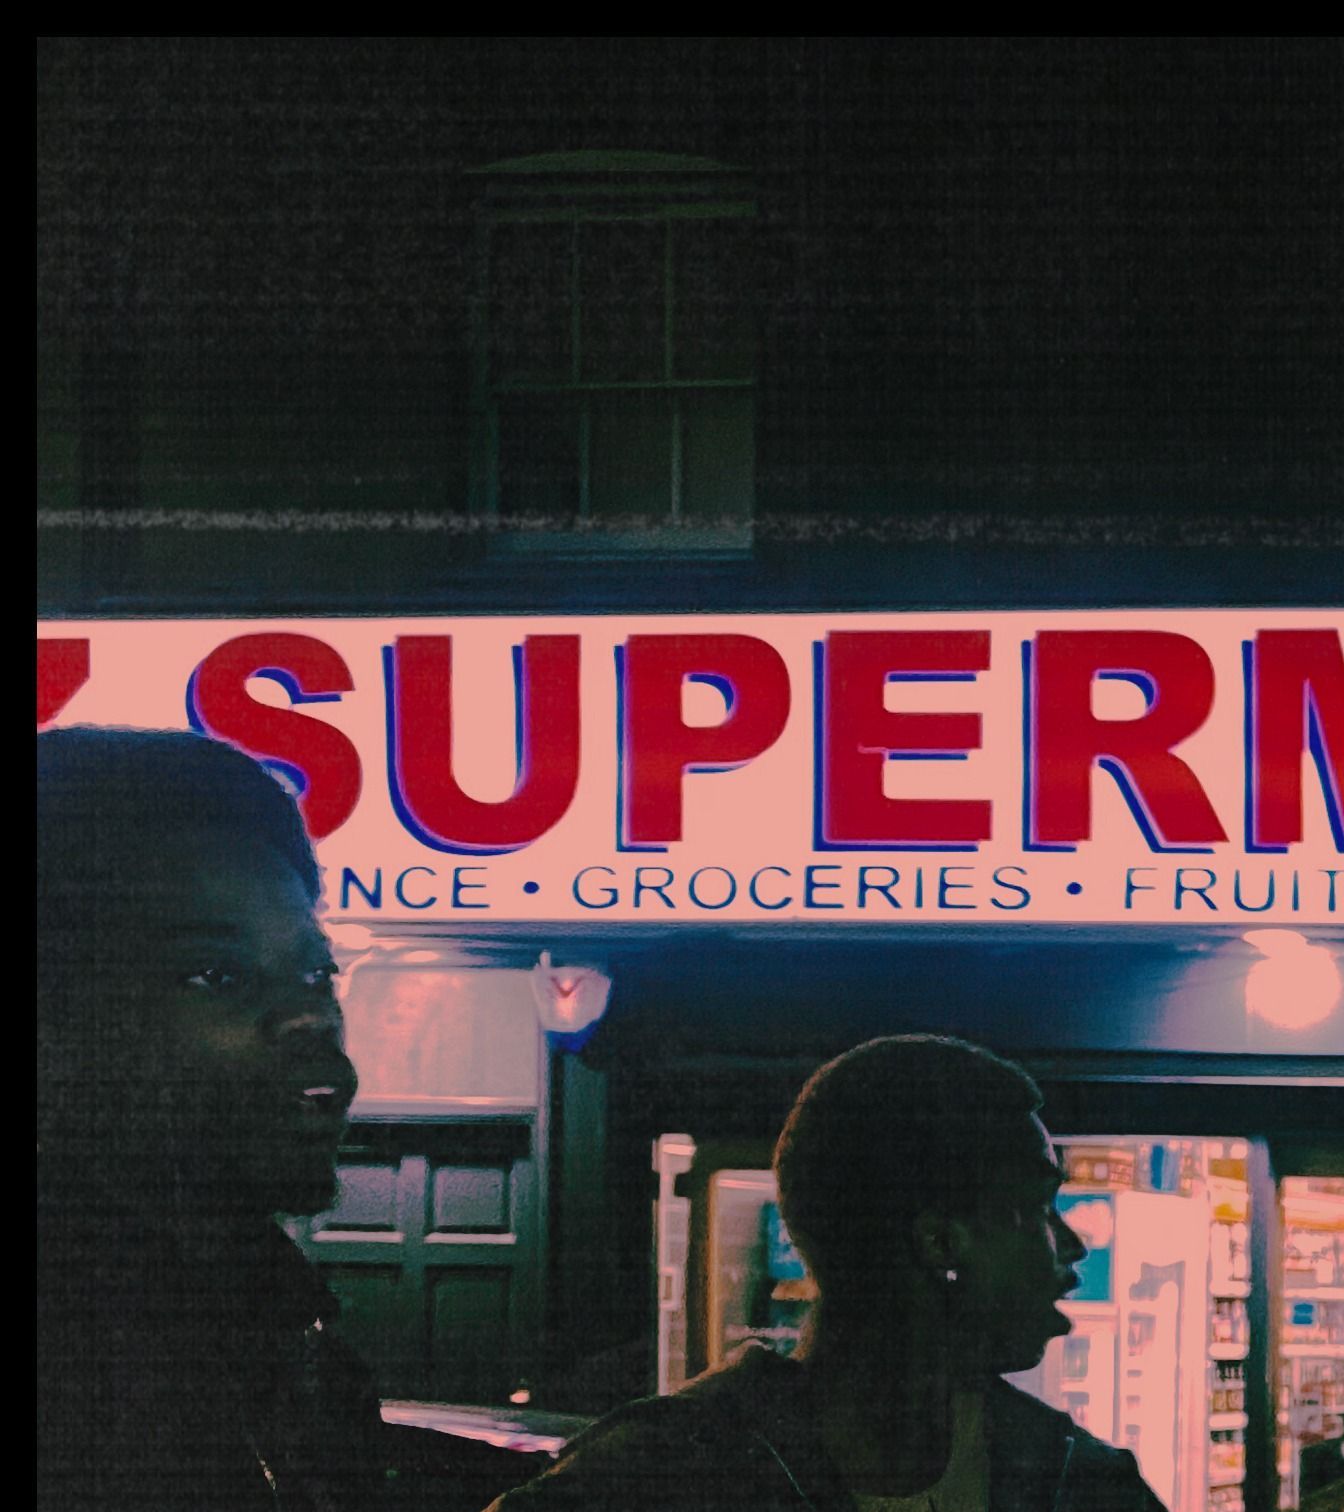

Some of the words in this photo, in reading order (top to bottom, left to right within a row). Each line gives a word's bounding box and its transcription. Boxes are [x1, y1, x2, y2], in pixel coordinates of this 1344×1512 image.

[318, 866, 490, 910] NCE
[572, 864, 1031, 911] GROCERIES
[1124, 866, 1341, 912] FRUIT
